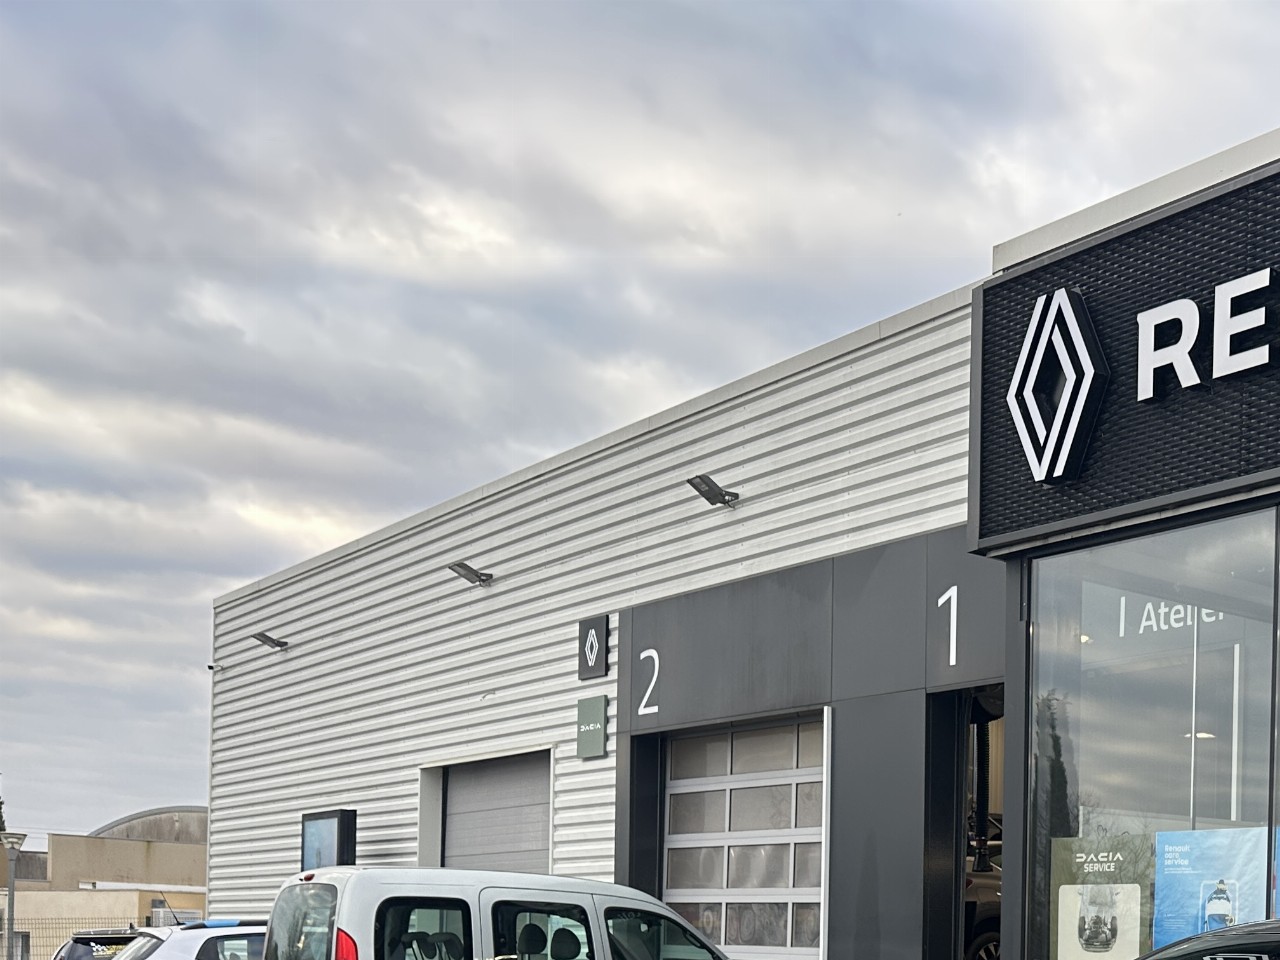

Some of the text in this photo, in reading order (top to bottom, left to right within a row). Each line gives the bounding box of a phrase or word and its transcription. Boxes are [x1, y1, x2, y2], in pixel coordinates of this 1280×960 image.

[937, 585, 958, 666] 1
[637, 648, 660, 716] 2
[579, 723, 602, 732] DACIA
[1164, 844, 1191, 852] Renault
[1075, 852, 1124, 863] DACIA
[1164, 858, 1190, 866] service
[1083, 862, 1116, 872] SERVICE
